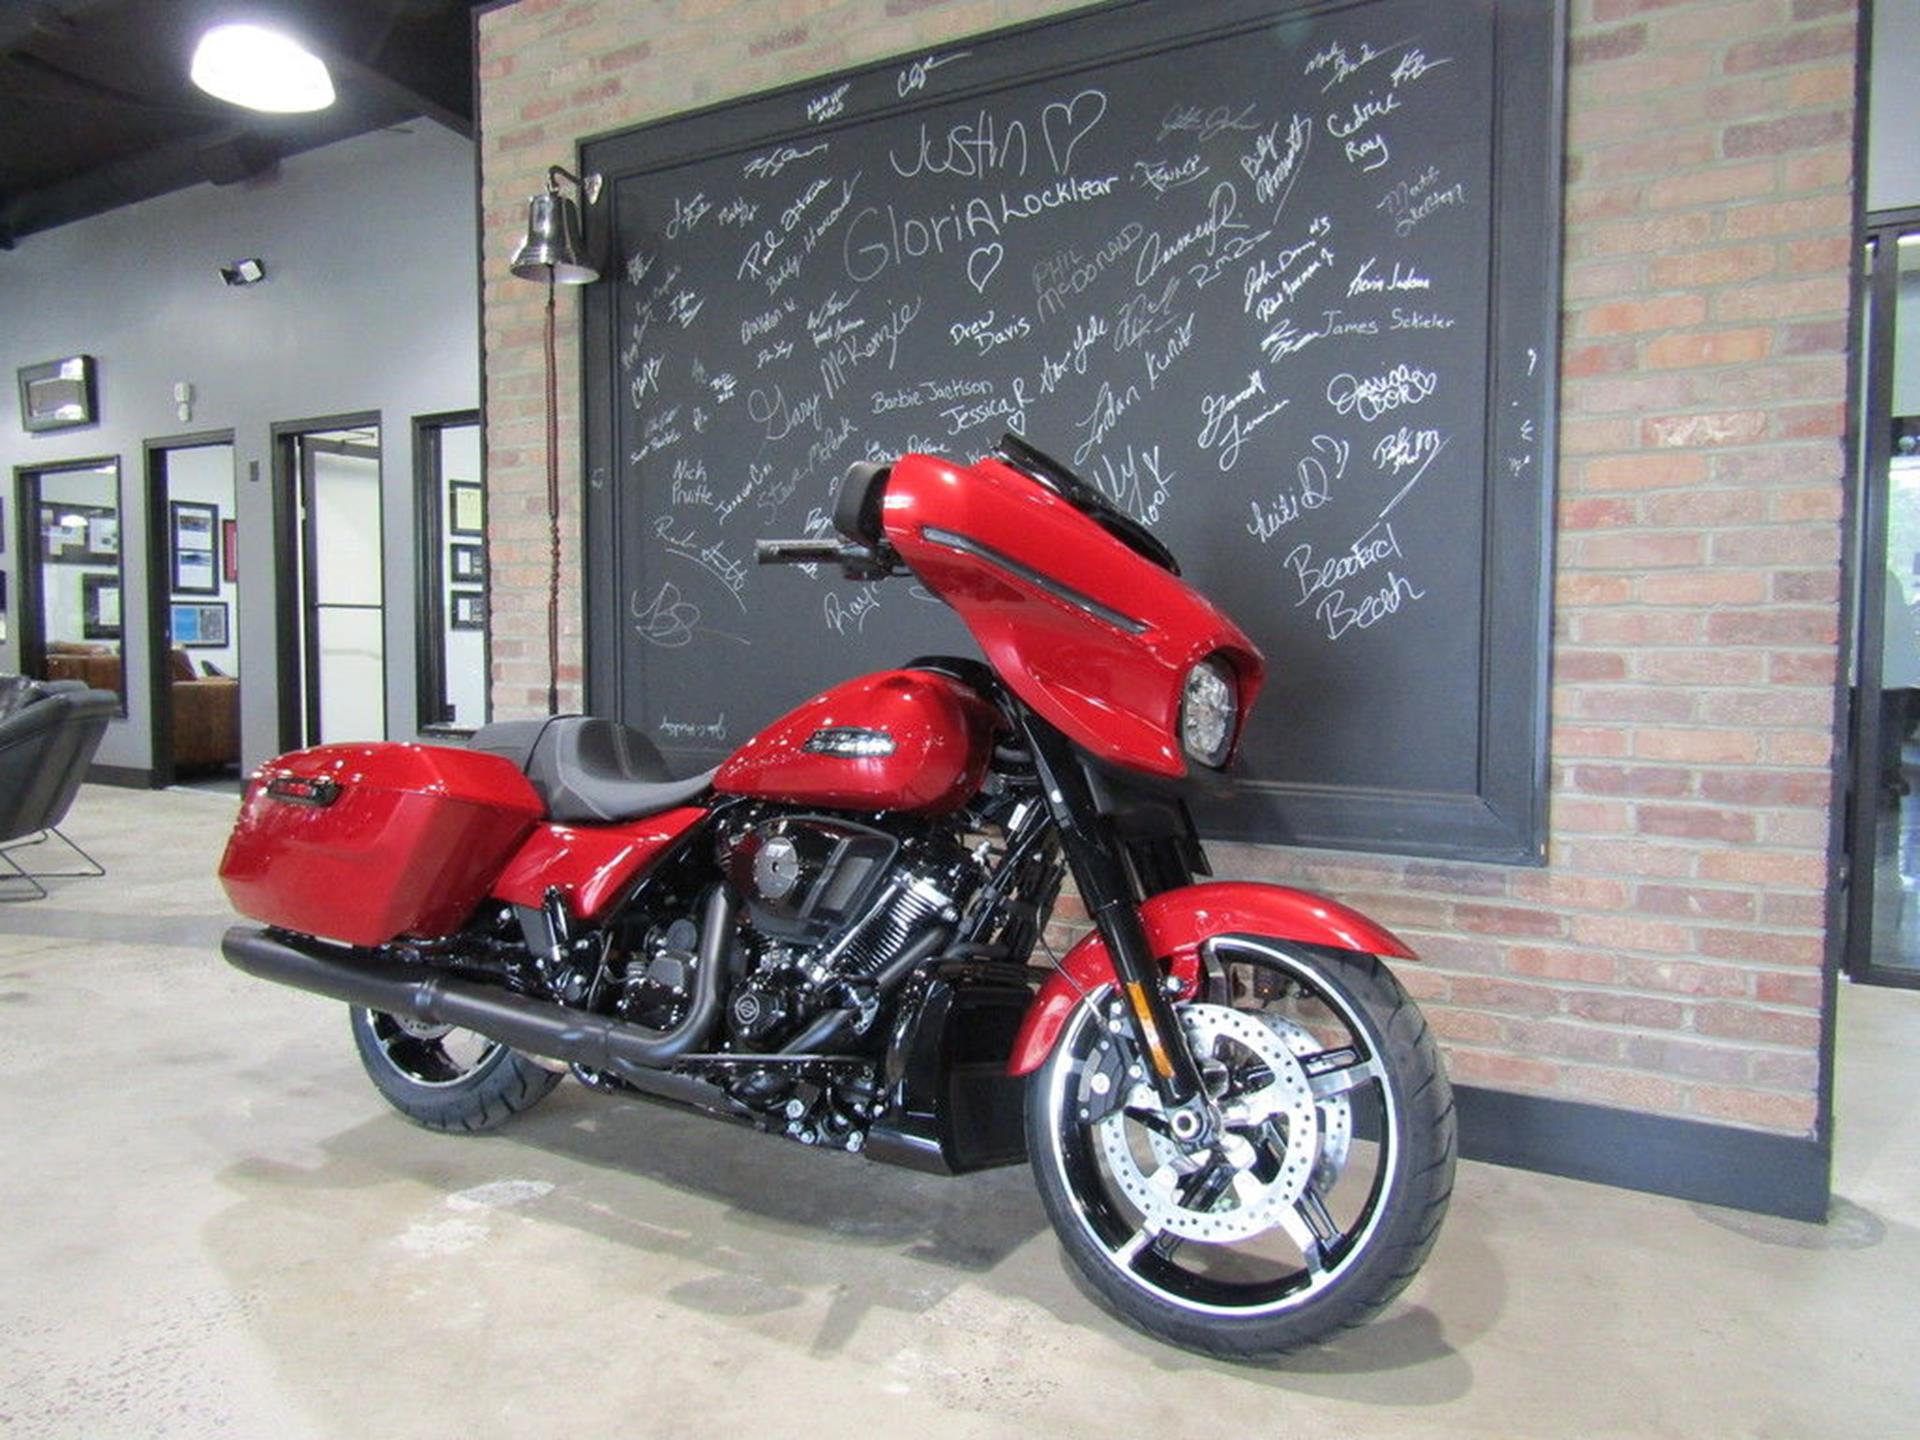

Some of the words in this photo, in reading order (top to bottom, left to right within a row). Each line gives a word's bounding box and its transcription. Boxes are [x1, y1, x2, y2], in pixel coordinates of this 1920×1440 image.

[1345, 134, 1389, 172] Ray
[950, 310, 995, 345] Drew
[975, 315, 1031, 356] Davis
[1320, 309, 1379, 338] James
[940, 397, 1016, 436] Jessica
